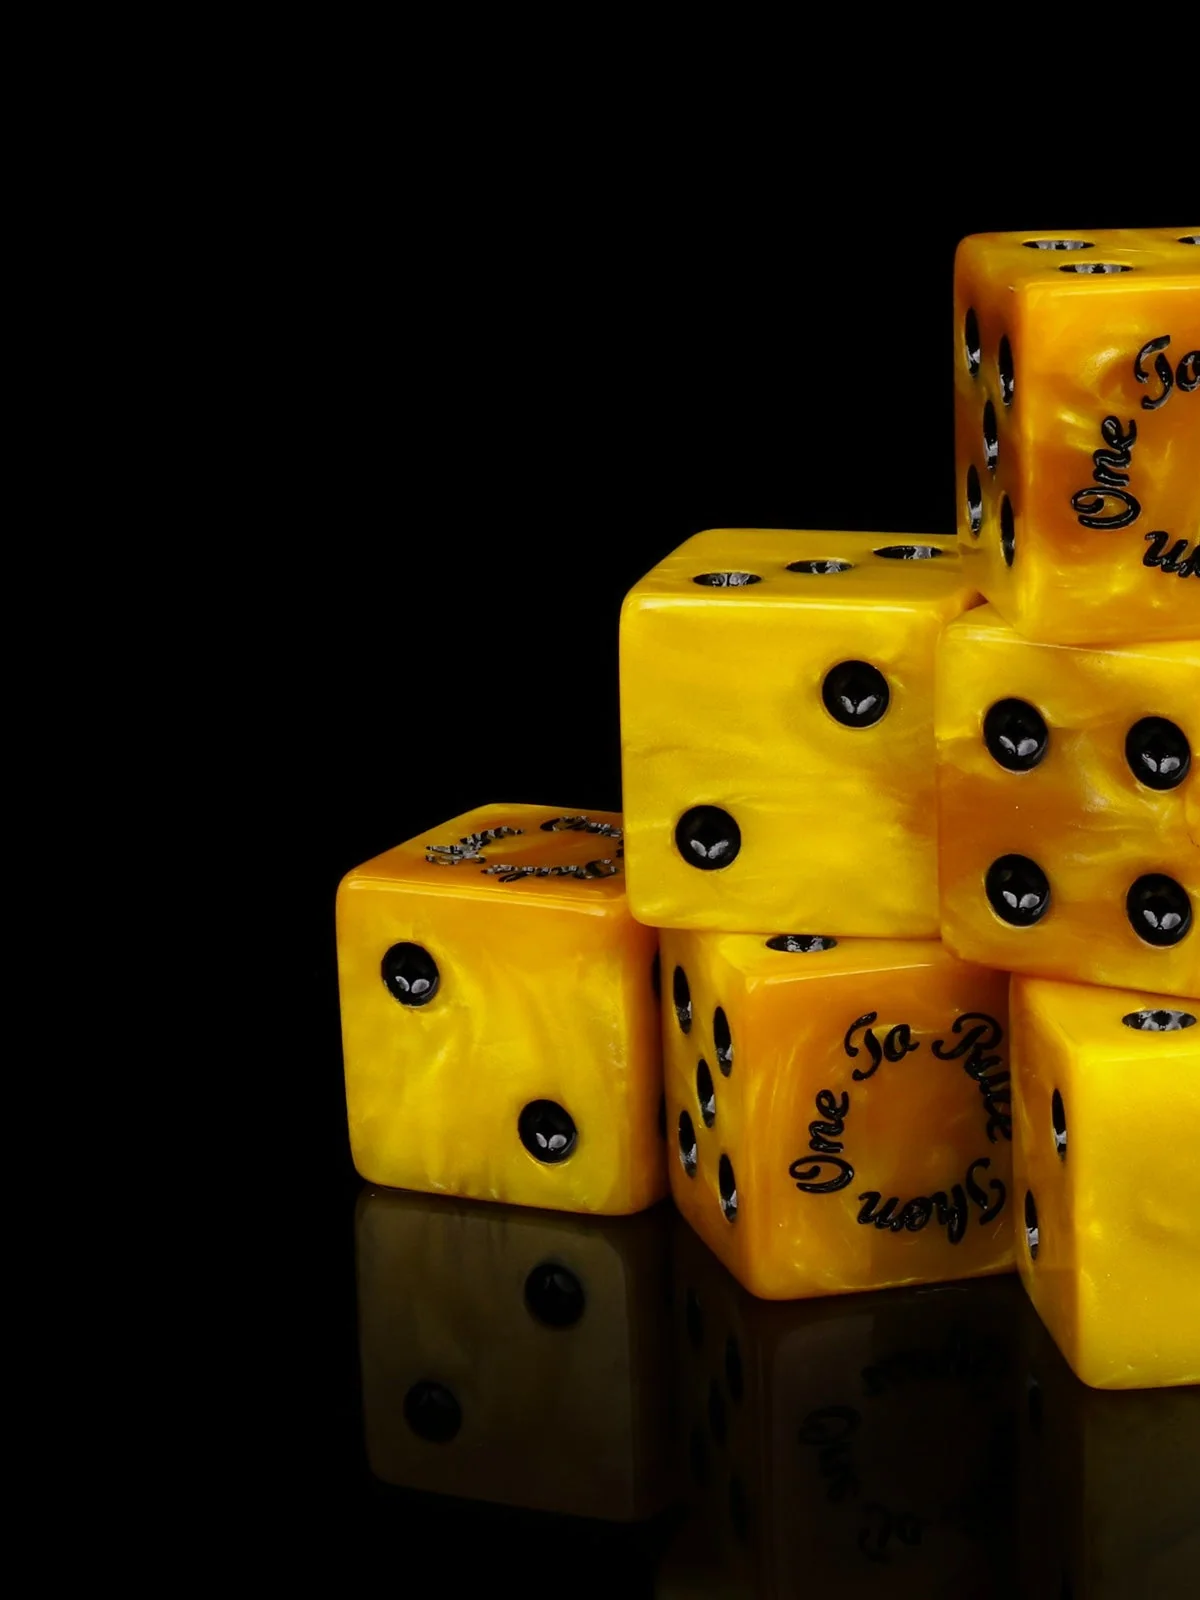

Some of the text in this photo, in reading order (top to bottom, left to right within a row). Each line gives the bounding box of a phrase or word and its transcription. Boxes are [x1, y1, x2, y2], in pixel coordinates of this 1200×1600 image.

[1070, 414, 1142, 530] One
[788, 1088, 855, 1194] One
[843, 1011, 921, 1082] To
